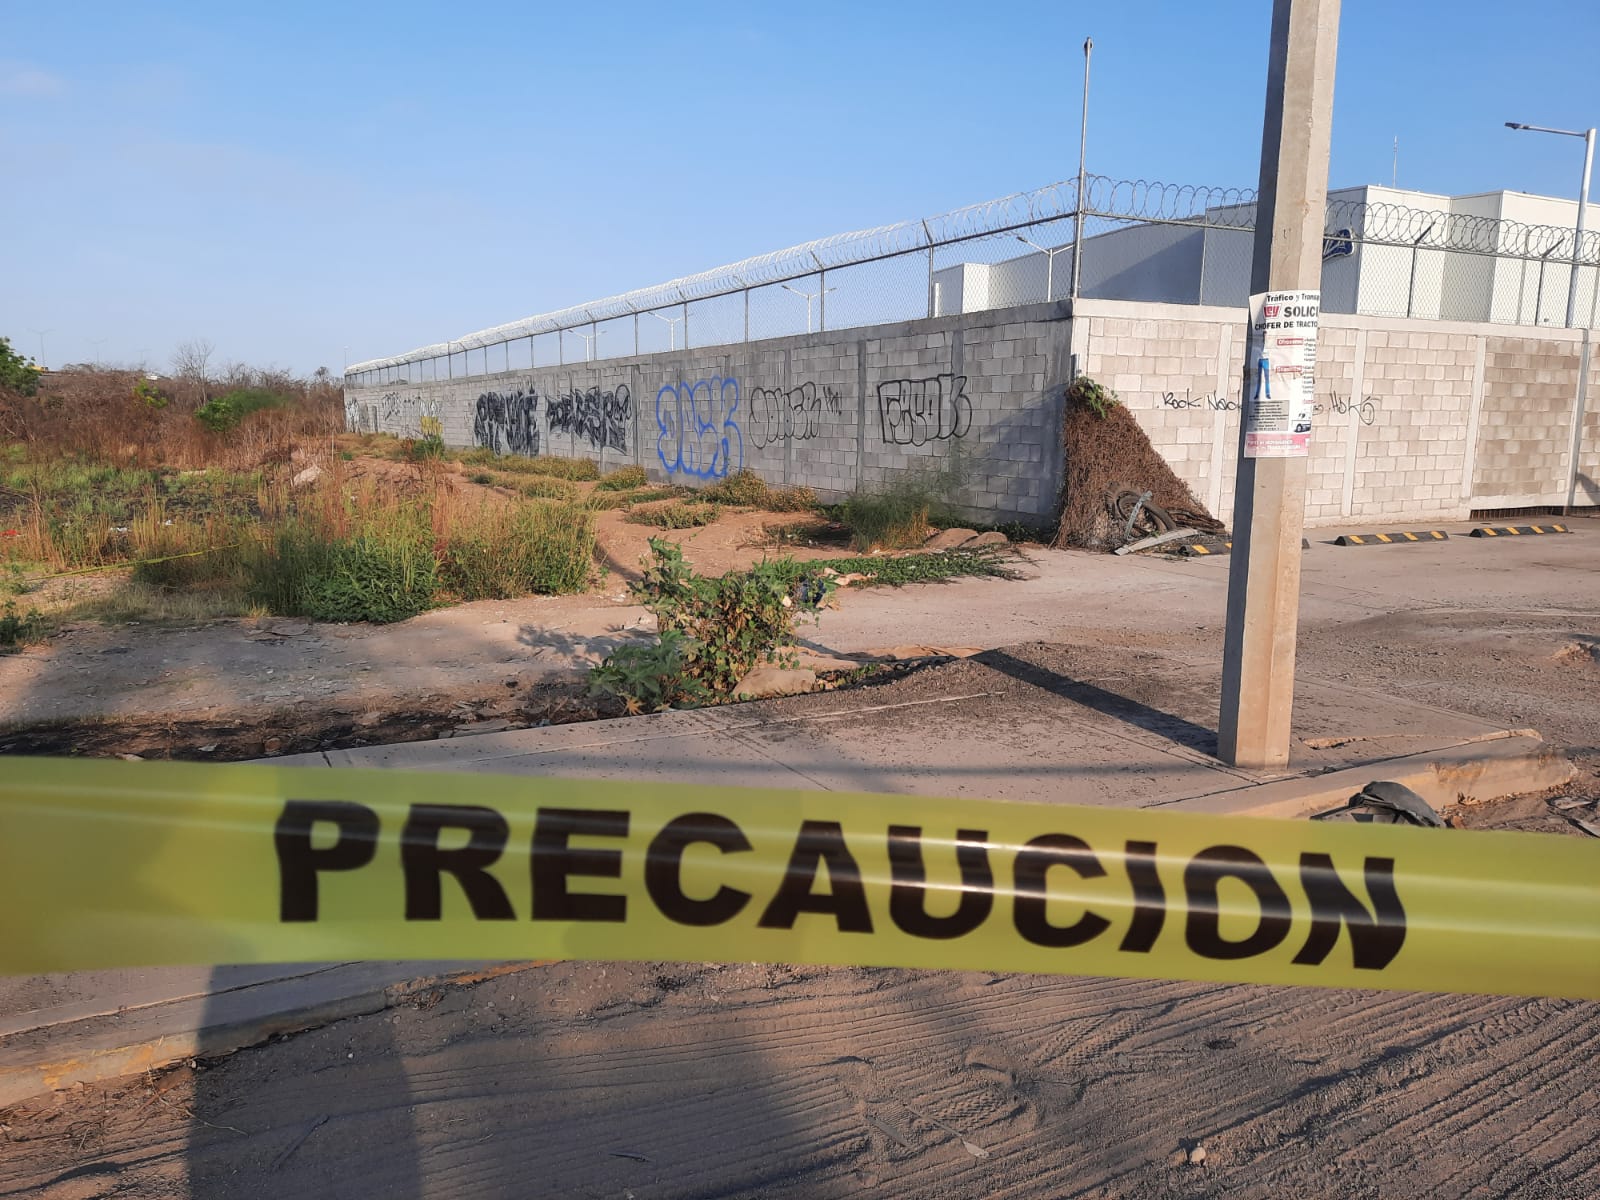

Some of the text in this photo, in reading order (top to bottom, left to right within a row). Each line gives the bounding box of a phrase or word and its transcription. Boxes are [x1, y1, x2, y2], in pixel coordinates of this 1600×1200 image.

[1266, 294, 1294, 303] Tráfico
[1255, 322, 1281, 330] CHOFER
[274, 799, 1407, 971] PRECAUCION
